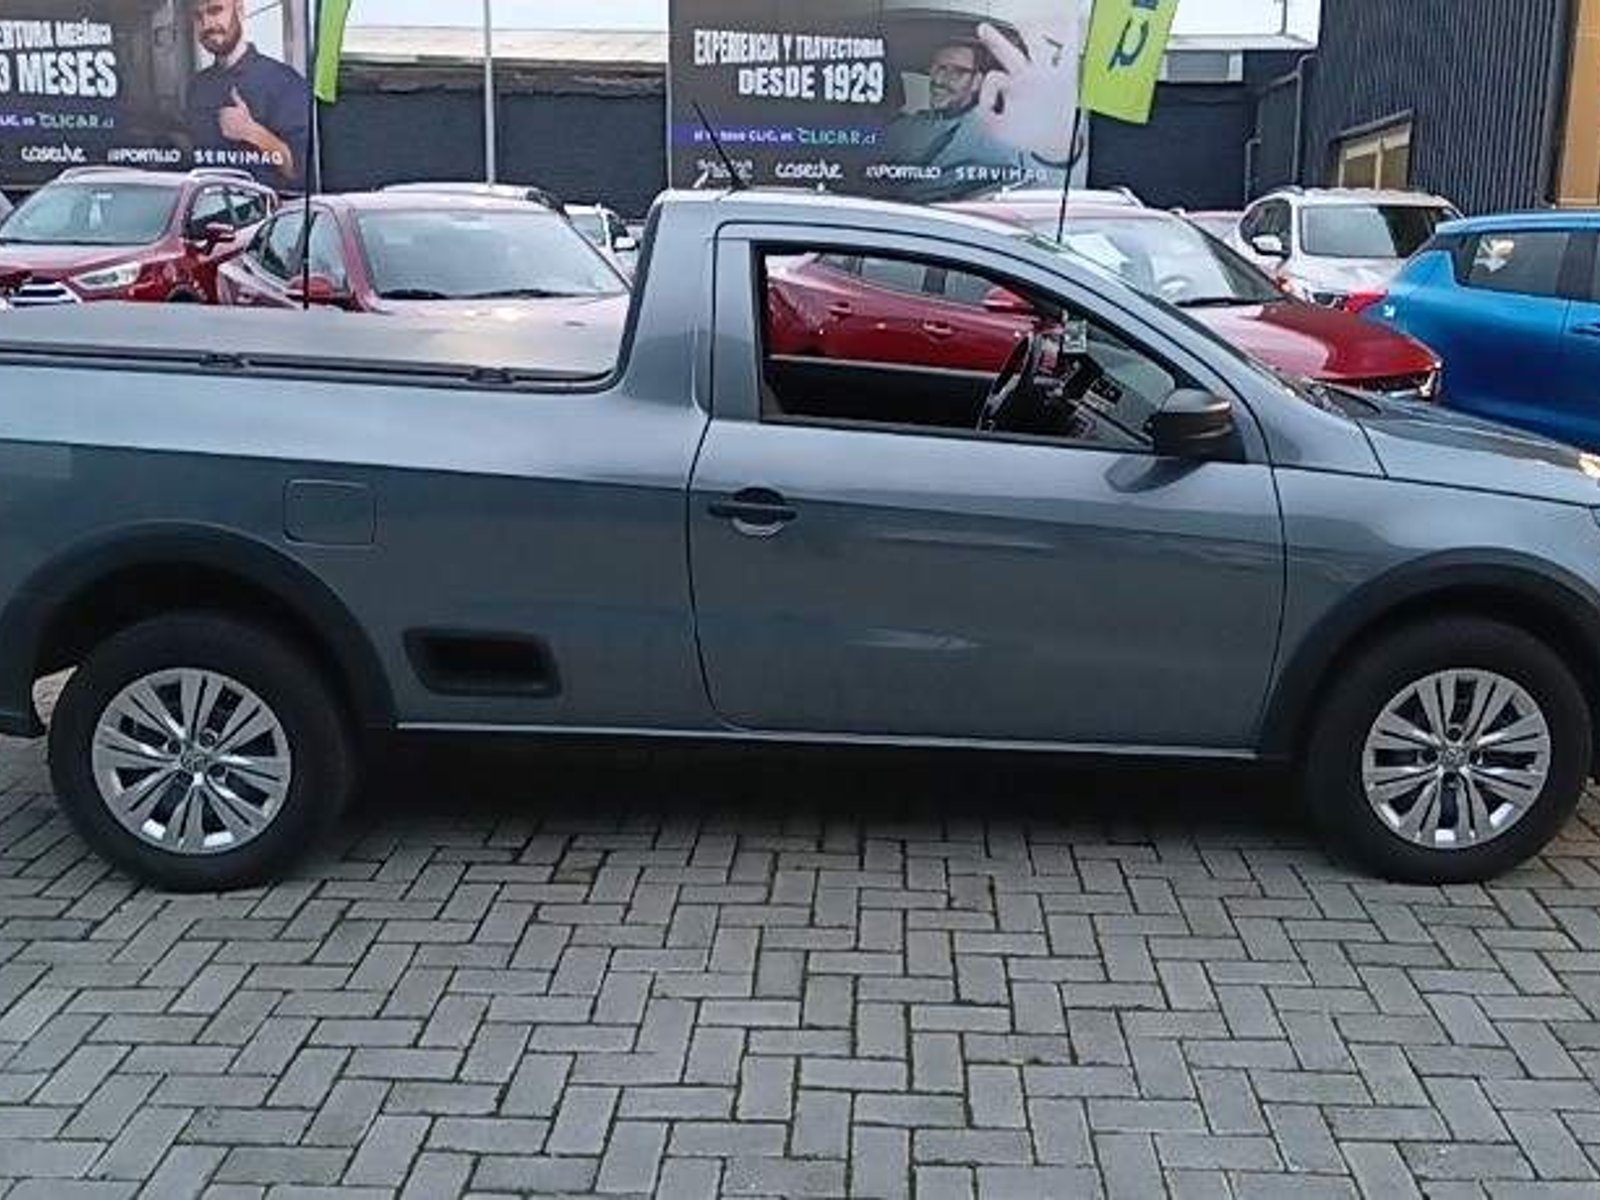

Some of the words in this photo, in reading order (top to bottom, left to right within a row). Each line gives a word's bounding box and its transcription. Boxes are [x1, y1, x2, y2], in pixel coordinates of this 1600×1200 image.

[694, 29, 780, 66] EXPERIENCIA
[783, 34, 793, 62] Y
[796, 35, 885, 61] TRAYECTORIA
[16, 50, 117, 98] MESES
[738, 65, 816, 99] DESDE
[822, 62, 884, 103] 1929
